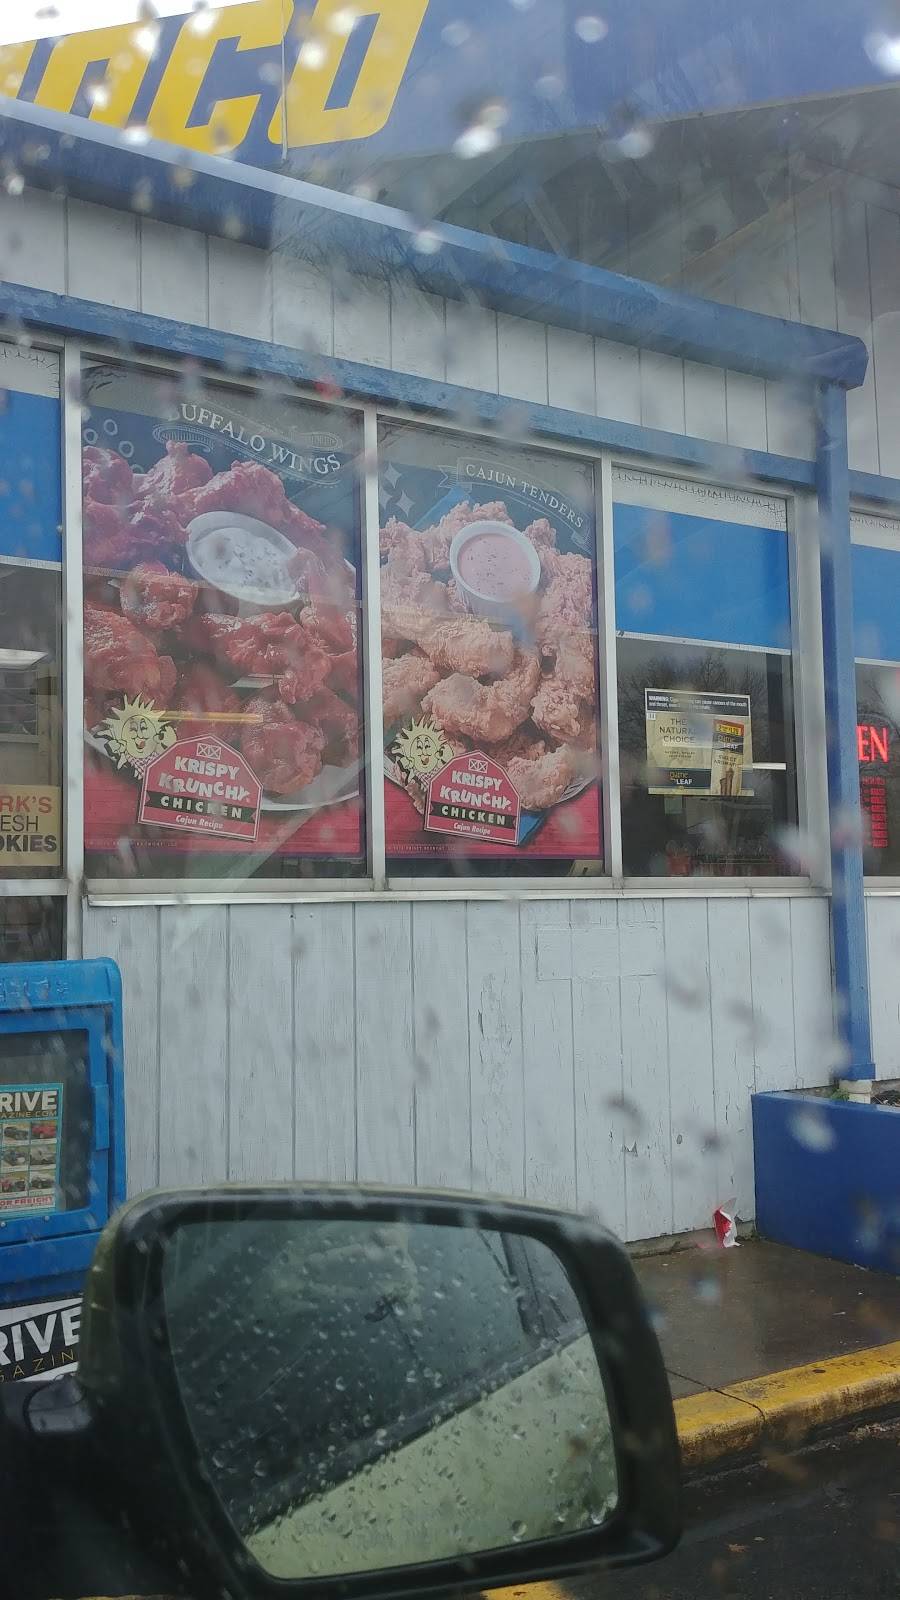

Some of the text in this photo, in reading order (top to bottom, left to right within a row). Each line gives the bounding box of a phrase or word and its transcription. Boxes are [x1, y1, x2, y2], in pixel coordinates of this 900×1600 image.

[0, 0, 429, 155] OCO
[268, 443, 341, 474] WINGS
[466, 464, 583, 528] CAJUN TENDERS
[659, 726, 697, 735] NATURA
[671, 718, 687, 726] THE
[663, 735, 696, 743] CHOICE
[174, 756, 240, 780] KRISPY
[158, 772, 250, 801] KRUNCHY
[451, 770, 503, 791] KRISPY
[160, 796, 242, 819] CHICKEN
[439, 785, 512, 810] KRUNCHY
[175, 815, 224, 830] Cajun Recipe
[441, 805, 506, 826] CHICKEN
[453, 822, 491, 836] Cajun Recipe
